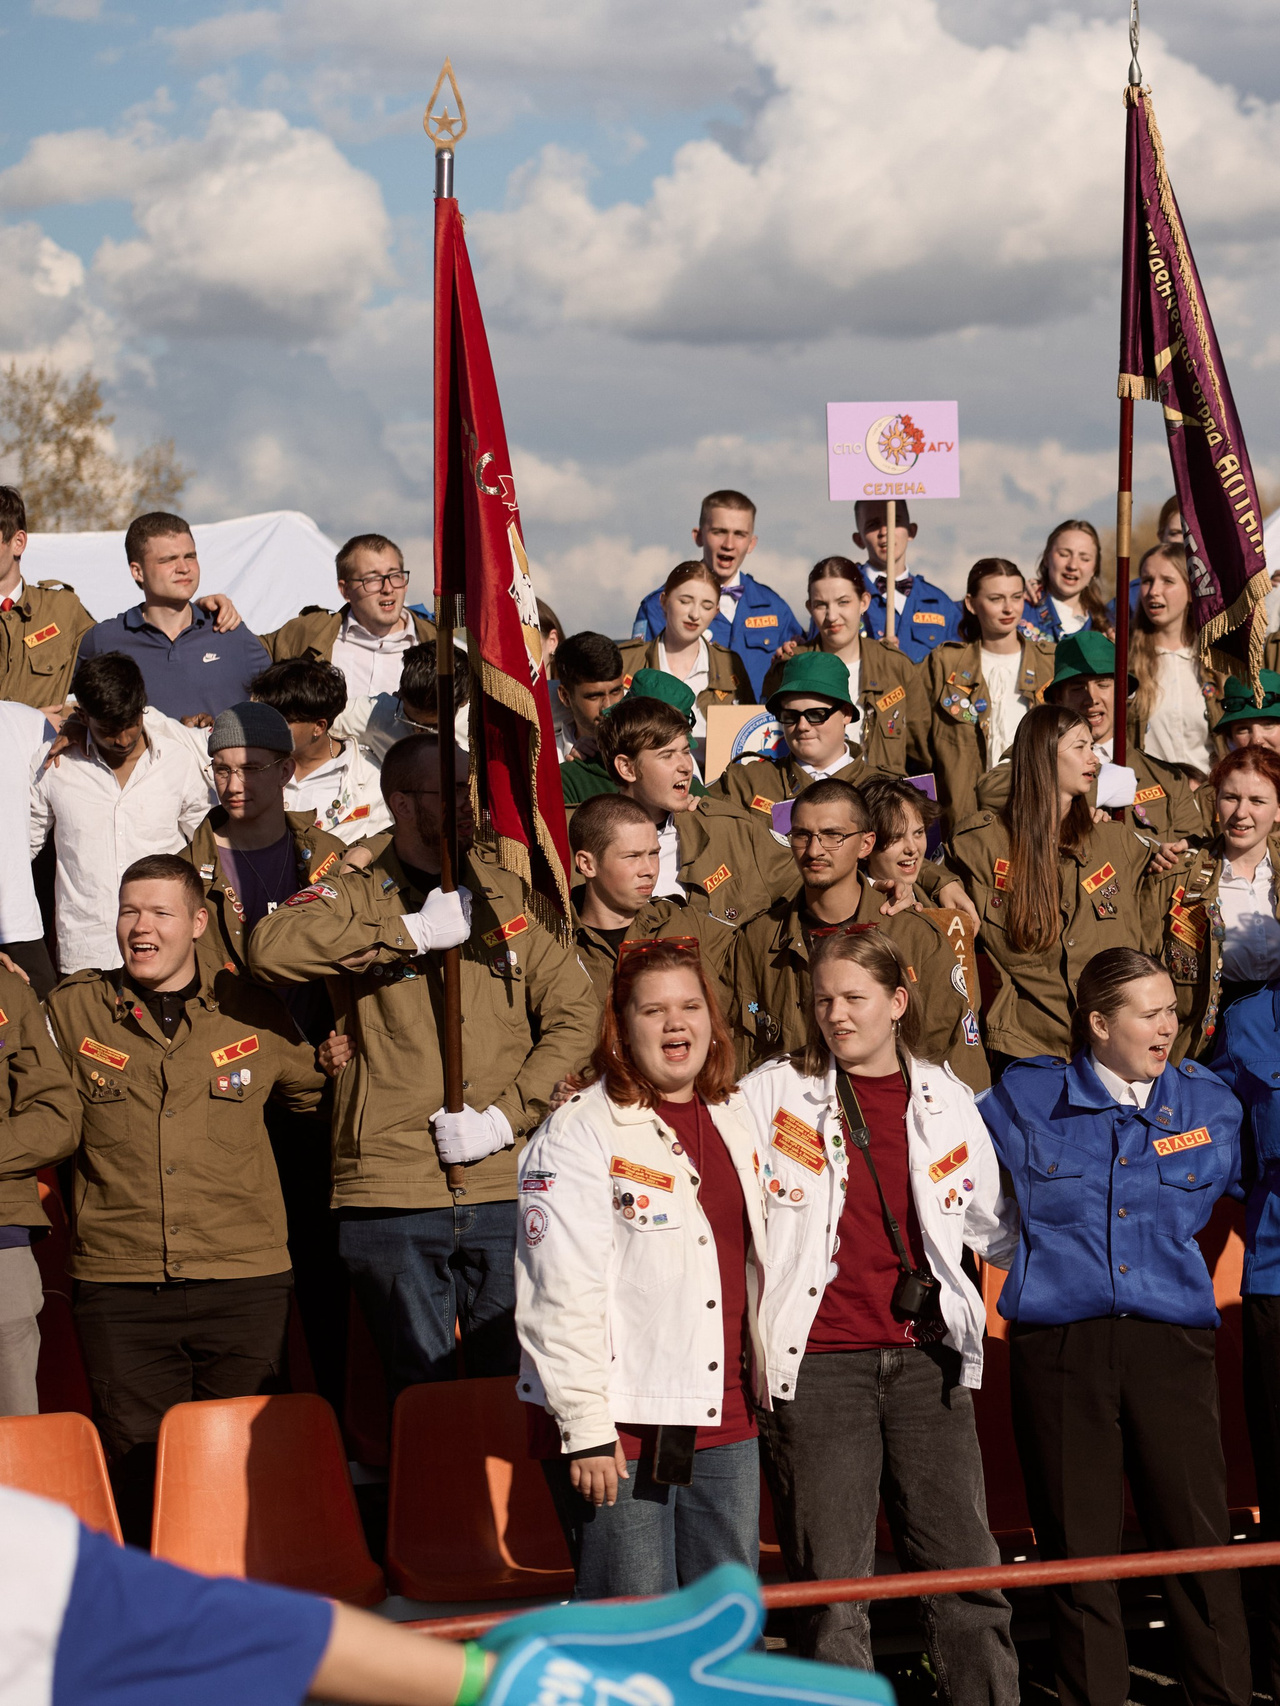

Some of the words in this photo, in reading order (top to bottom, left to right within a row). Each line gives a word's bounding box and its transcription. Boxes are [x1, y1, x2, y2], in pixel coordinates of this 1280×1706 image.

[833, 442, 864, 455] СПО
[928, 442, 954, 453] АГУ
[863, 482, 926, 495] СЕЛЕНА
[1174, 1130, 1208, 1149] ЛСО
